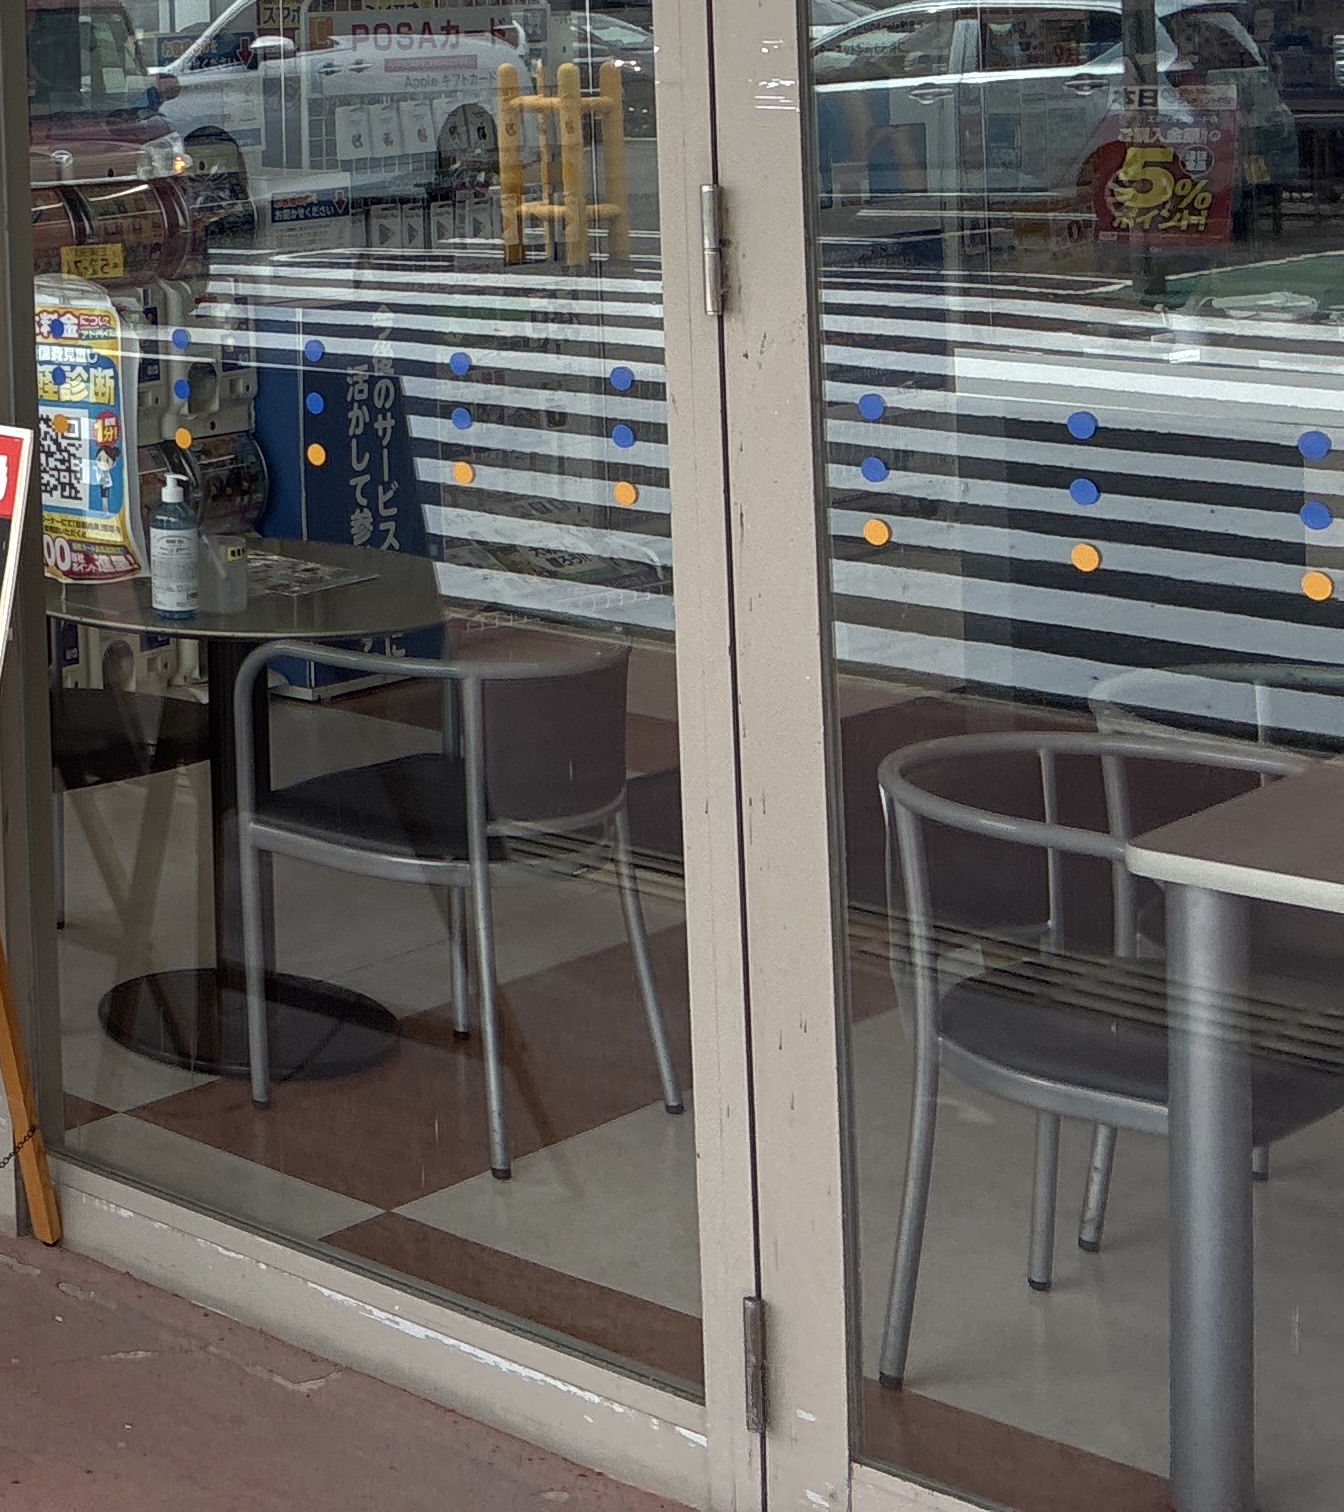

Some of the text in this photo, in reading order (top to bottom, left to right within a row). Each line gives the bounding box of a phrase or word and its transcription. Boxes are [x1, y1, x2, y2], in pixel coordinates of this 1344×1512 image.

[351, 17, 509, 49] POSAカード
[404, 74, 439, 89] Apple
